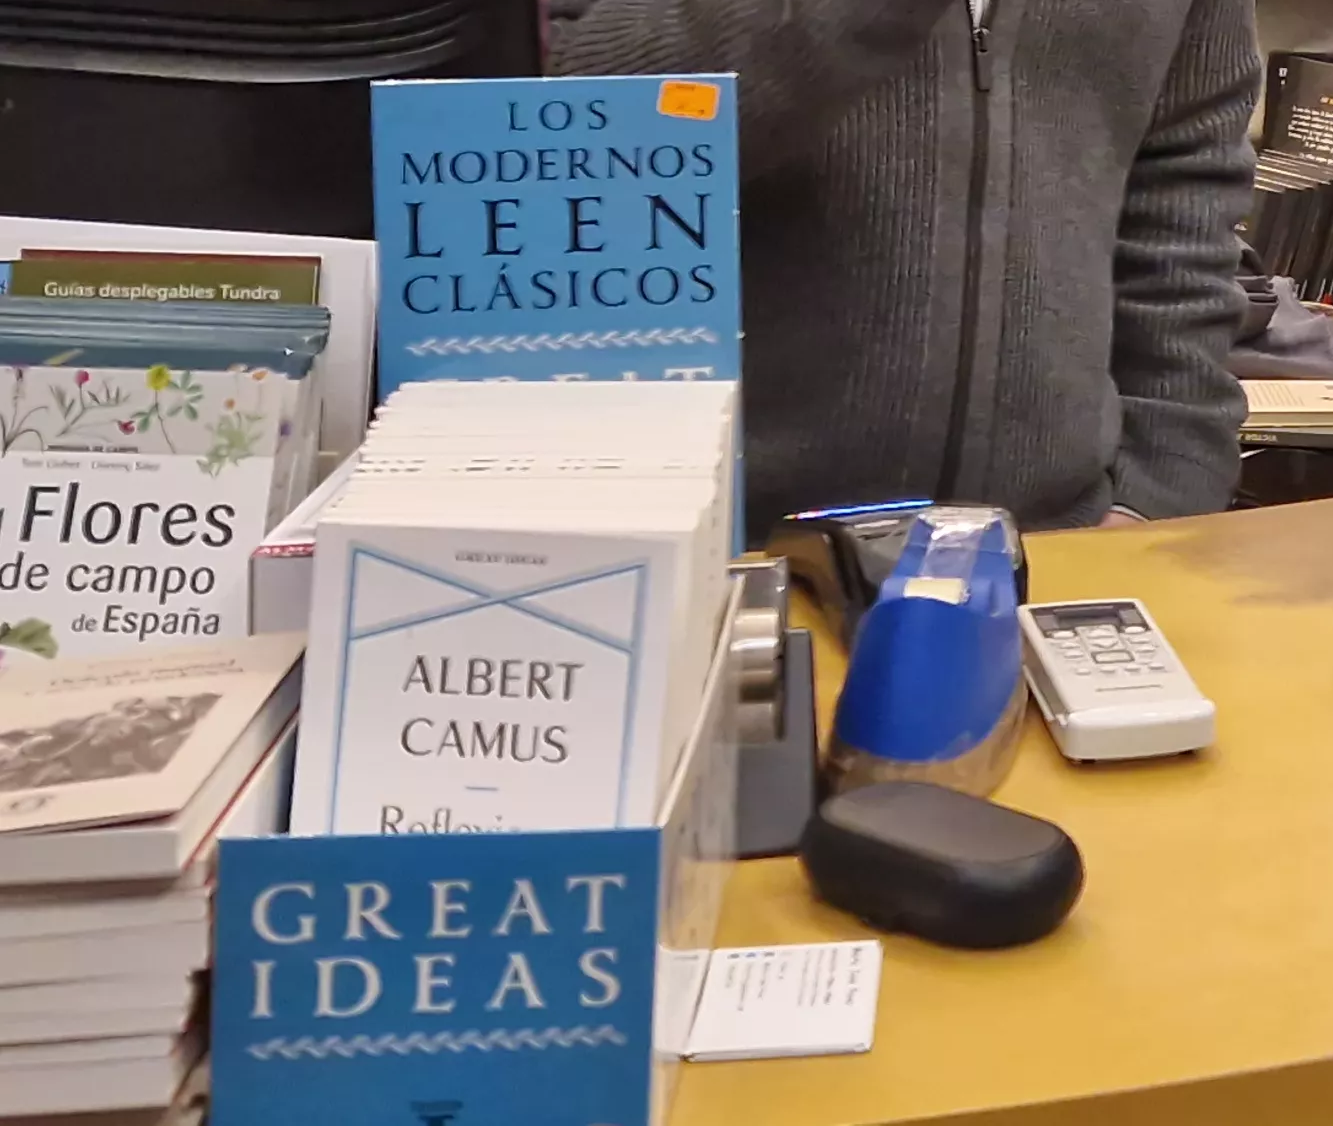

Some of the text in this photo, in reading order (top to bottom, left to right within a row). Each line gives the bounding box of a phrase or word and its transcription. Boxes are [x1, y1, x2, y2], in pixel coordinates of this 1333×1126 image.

[506, 98, 609, 133] LOS
[399, 143, 715, 186] MODERNOS
[404, 192, 713, 260] LEEN
[44, 281, 280, 302] Guías desplegables Tundra
[401, 263, 717, 316] CLÁSICOS
[18, 481, 237, 548] Flores
[0, 551, 216, 605] de campo
[71, 604, 221, 642] de España
[402, 653, 585, 704] ALBERT
[399, 718, 570, 766] CAMUS
[250, 874, 627, 947] GREAT
[248, 947, 622, 1021] IDEAS
